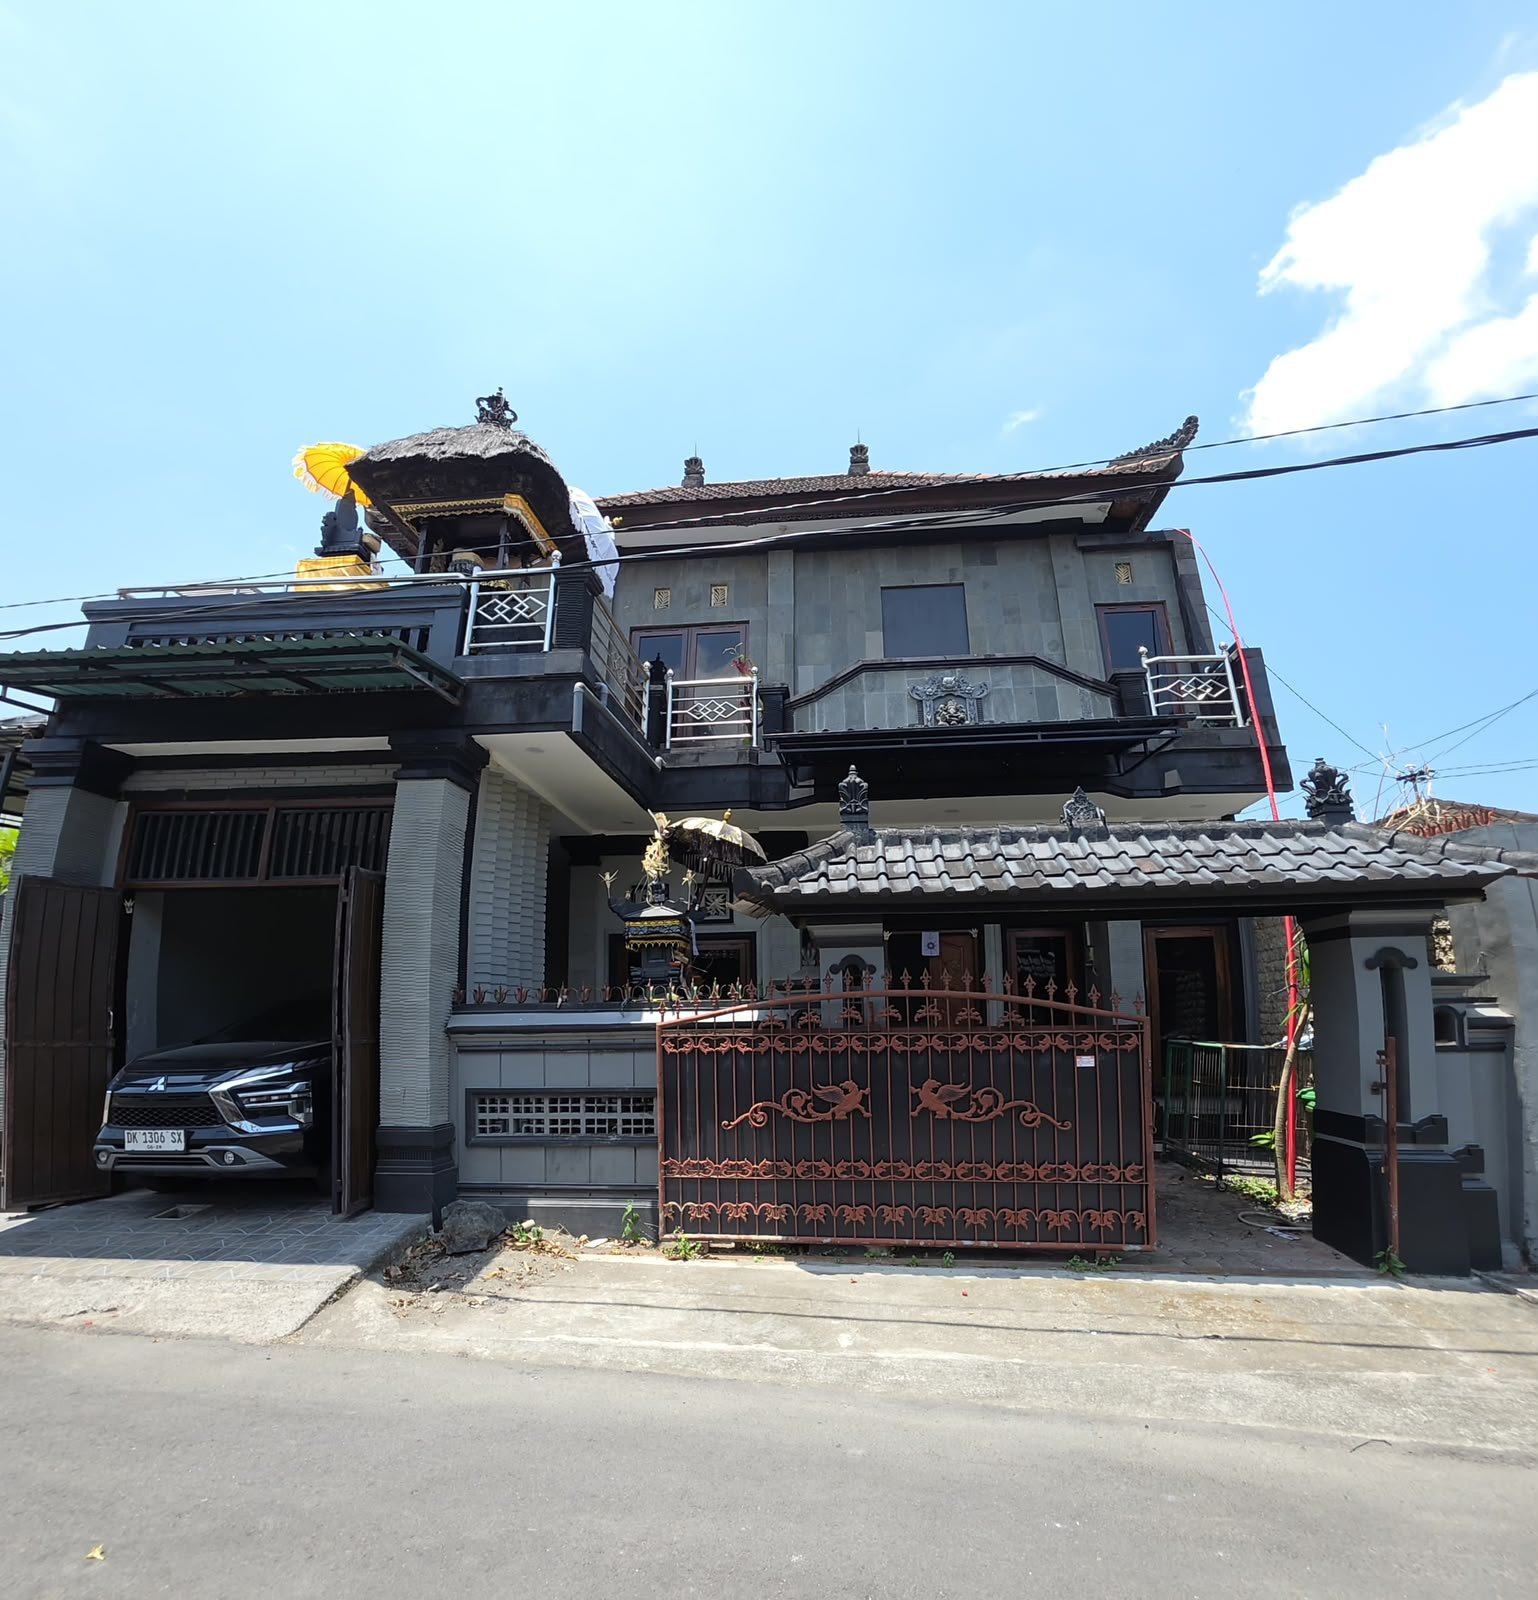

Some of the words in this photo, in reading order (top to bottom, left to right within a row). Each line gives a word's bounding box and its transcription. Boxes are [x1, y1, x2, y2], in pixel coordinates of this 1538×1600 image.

[126, 1131, 138, 1144] DK
[142, 1131, 166, 1144] 1306
[170, 1131, 183, 1144] SX
